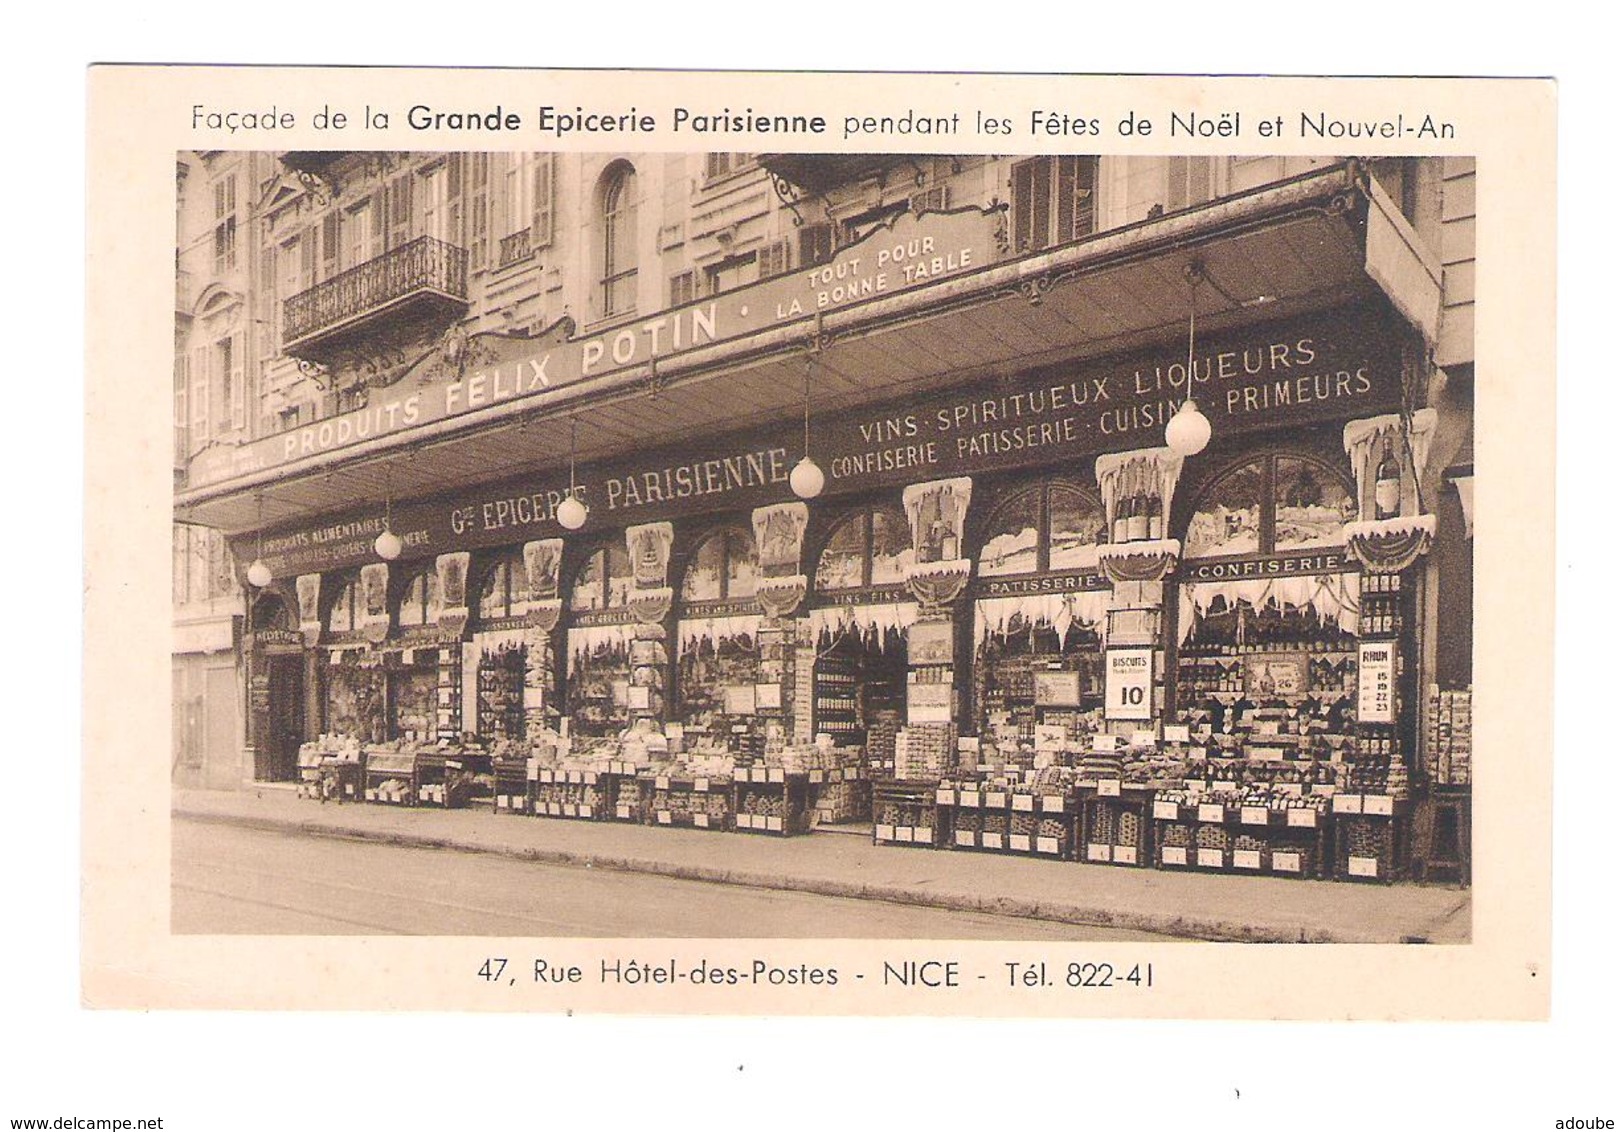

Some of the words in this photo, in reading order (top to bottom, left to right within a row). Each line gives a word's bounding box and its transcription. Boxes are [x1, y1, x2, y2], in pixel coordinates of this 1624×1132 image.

[191, 105, 295, 132] Façade
[313, 105, 348, 130] de
[365, 105, 390, 130] la
[407, 106, 522, 131] Grande
[538, 106, 656, 137] Epicerie
[673, 108, 827, 134] Parisienne
[844, 111, 960, 139] pendant
[977, 110, 1013, 136] les
[1031, 109, 1100, 136] Fêtes
[1118, 111, 1153, 137] de
[1171, 111, 1241, 138] Noël
[1258, 115, 1285, 138] et
[1301, 112, 1456, 140] Nouvel-An
[808, 259, 860, 289] TOUT
[878, 236, 935, 268] POUR
[776, 299, 803, 320] LA
[817, 273, 888, 308] BONNE
[903, 248, 973, 283] TABLE
[284, 402, 420, 460] PRODUITS
[445, 354, 551, 414] FÉLIX
[582, 303, 717, 375] POTIN
[859, 415, 919, 443] VINS
[937, 377, 1111, 432] SPIRITUEUX
[1134, 338, 1317, 395] LIQUEURS
[831, 441, 939, 480] CONFISERIE
[957, 417, 1078, 459] PATISSERIE
[1099, 396, 1200, 435] CUISIN
[1226, 367, 1372, 414] PRIMEURS
[606, 447, 790, 511] PARISIENNE
[312, 516, 390, 545] ALIMENTAIRES
[1198, 556, 1339, 579] CONFISERIE
[834, 593, 861, 605] VINS
[871, 590, 900, 602] FINS
[989, 574, 1097, 594] PATISSERIE
[727, 600, 762, 613] SPIRITS
[1112, 656, 1148, 668] BISCUITS
[1362, 650, 1388, 663] RHUM
[477, 958, 517, 990] 47,
[534, 960, 582, 984] Rue
[601, 958, 839, 987] Hôtel-des-Postes
[884, 961, 961, 988] NICE
[1004, 961, 1054, 988] Tél.
[1065, 962, 1155, 989] 822-41
